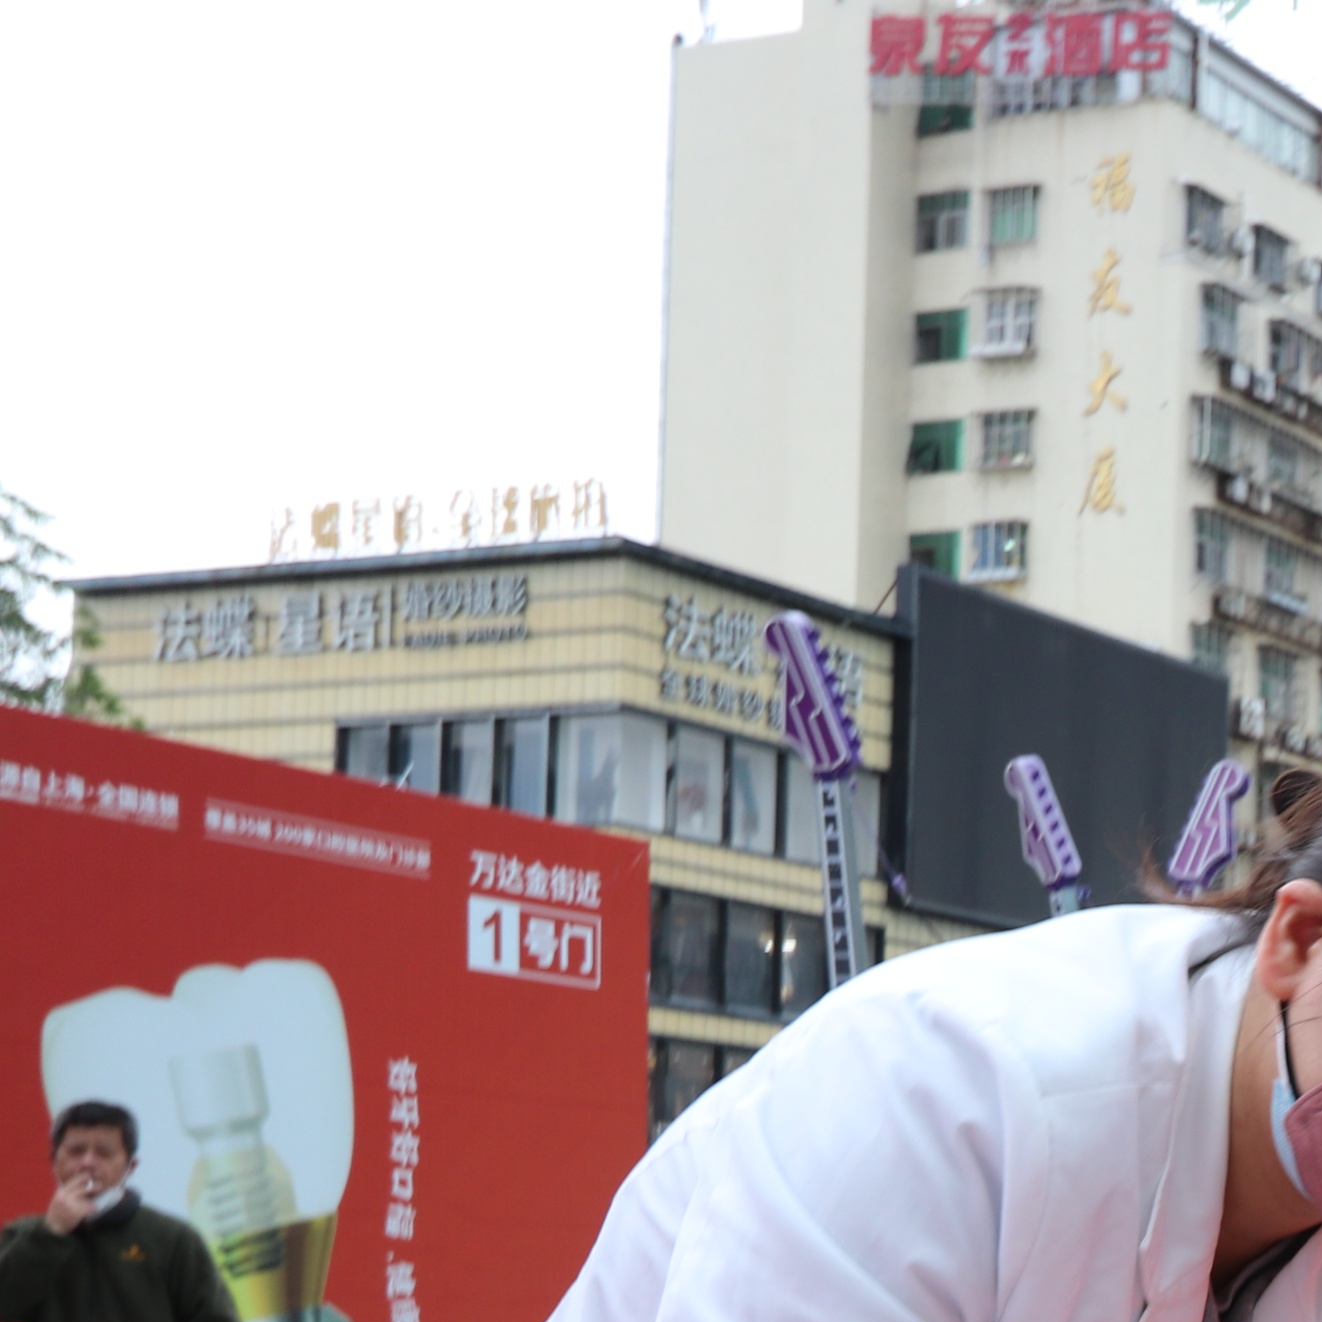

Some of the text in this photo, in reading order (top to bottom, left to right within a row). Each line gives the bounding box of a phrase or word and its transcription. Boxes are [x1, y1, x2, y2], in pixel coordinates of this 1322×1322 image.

[469, 850, 601, 909] 万达金街近
[483, 910, 595, 975] 1号门
